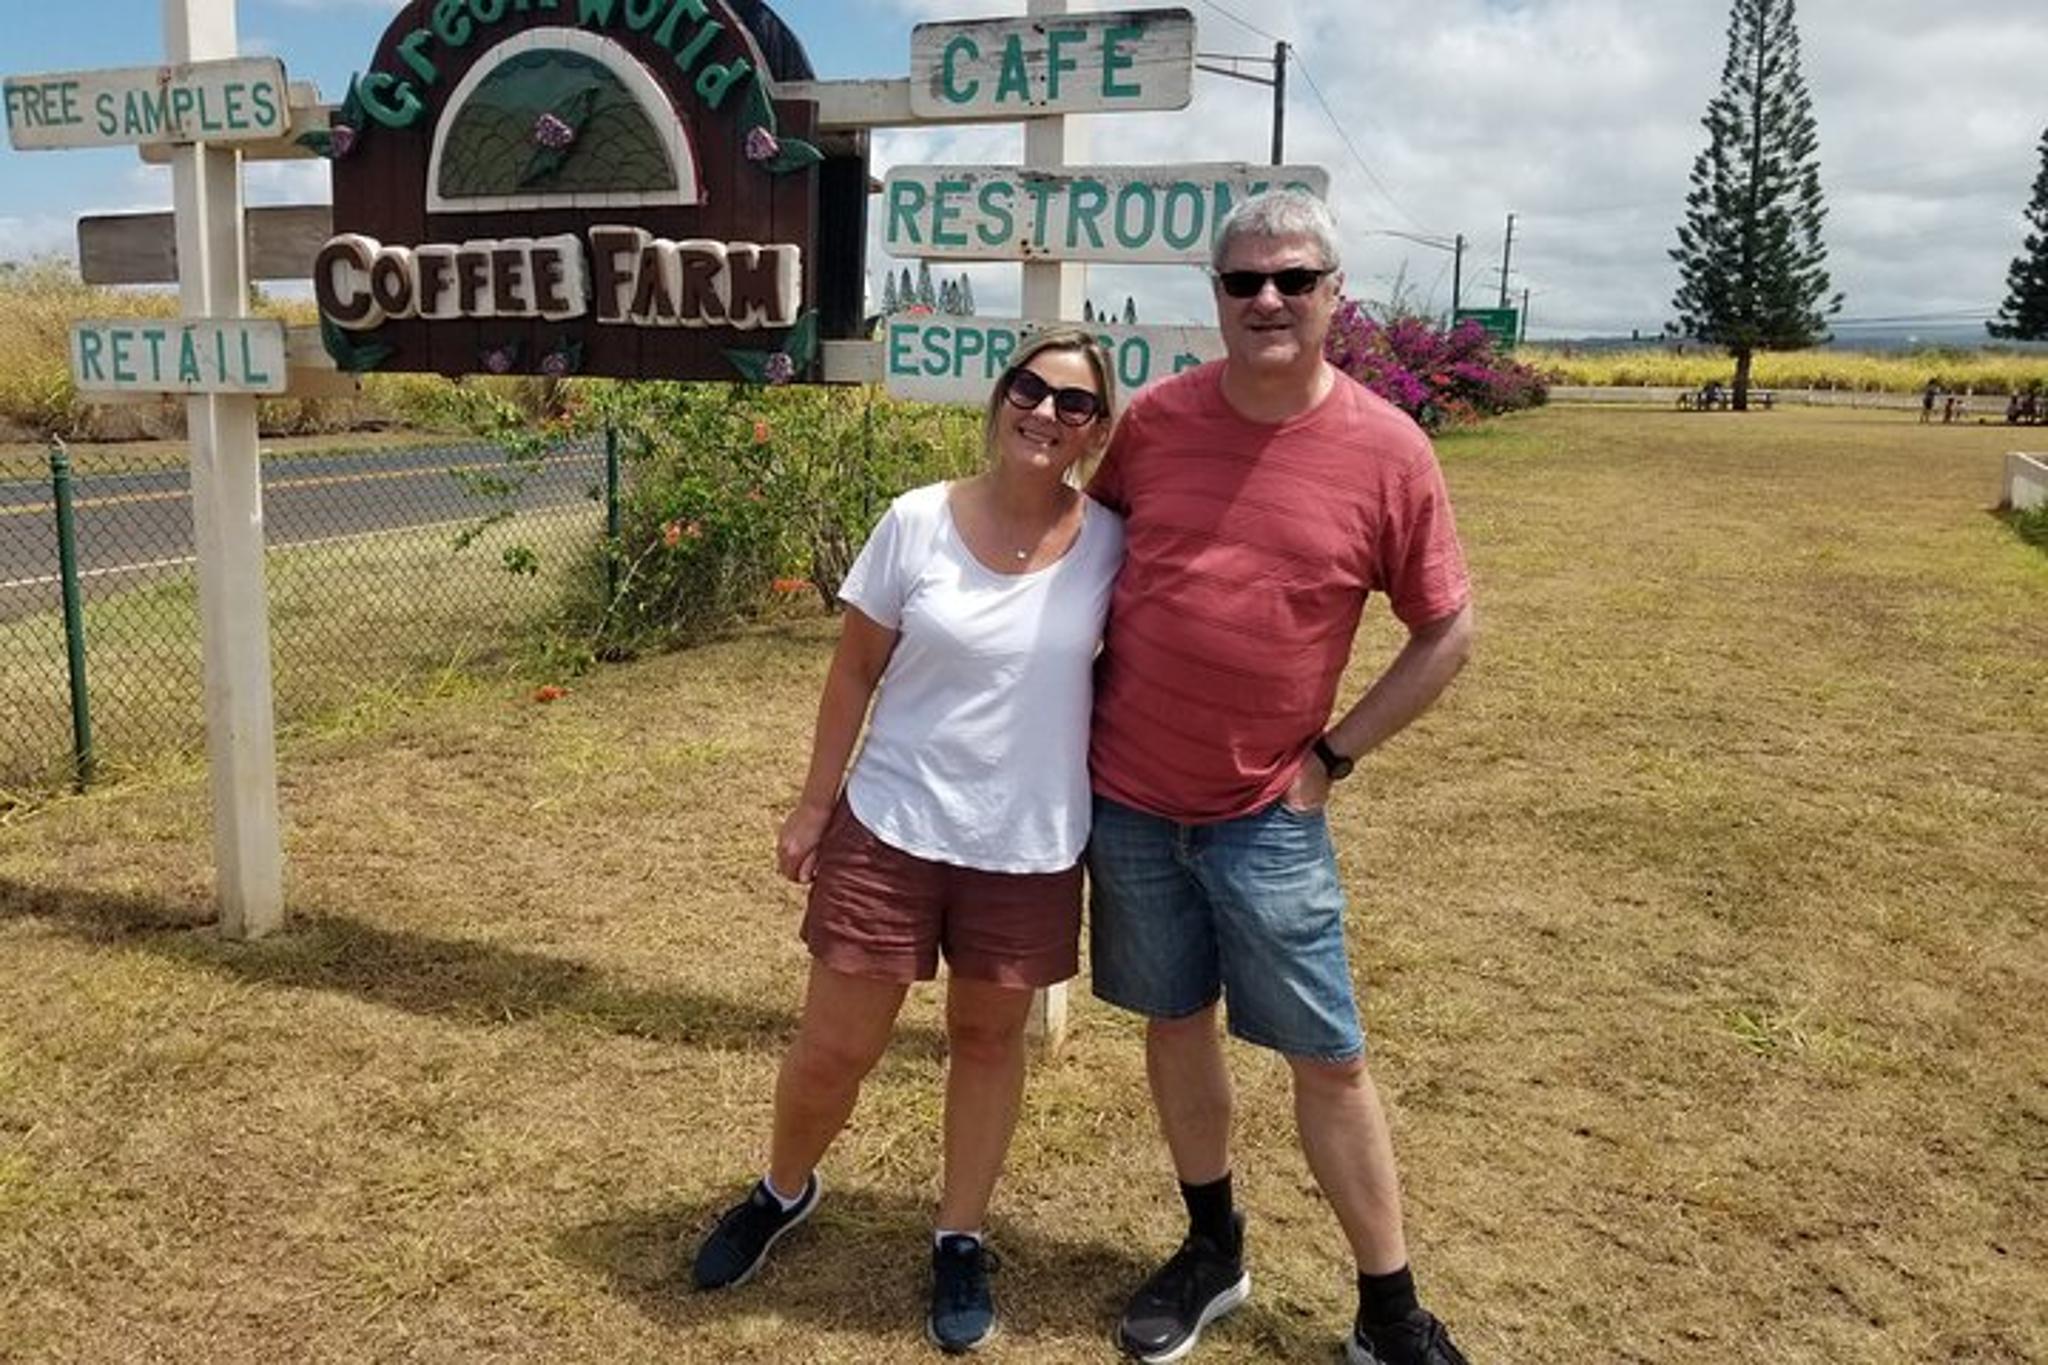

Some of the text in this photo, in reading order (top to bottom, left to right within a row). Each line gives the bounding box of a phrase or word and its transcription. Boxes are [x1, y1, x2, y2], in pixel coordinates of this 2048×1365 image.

[356, 0, 560, 127] Gre
[942, 27, 1142, 103] CAFE
[3, 82, 276, 136] FREE SAMPLES
[887, 180, 1314, 250] RESTROO
[80, 329, 269, 383] RETAIL
[889, 324, 1150, 388] ESPRO
